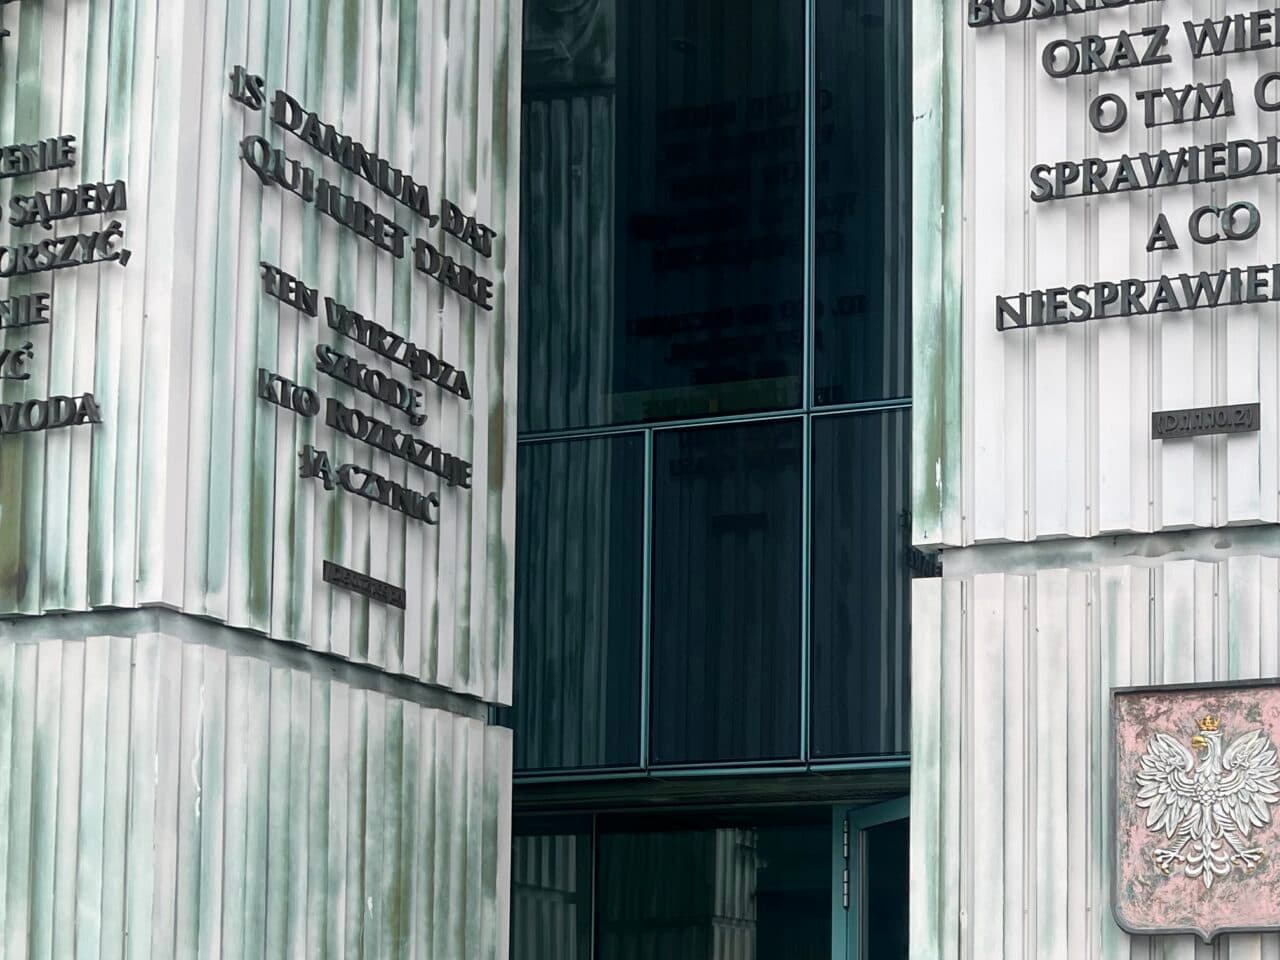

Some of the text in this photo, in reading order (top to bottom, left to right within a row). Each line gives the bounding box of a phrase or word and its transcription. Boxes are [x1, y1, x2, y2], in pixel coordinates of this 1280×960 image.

[1041, 25, 1172, 78] ORAZ
[1089, 92, 1128, 133] O
[1135, 79, 1236, 128] TYM
[230, 65, 497, 258] IS DAMNUM, DAT
[9, 180, 127, 230] SĄDEM
[240, 135, 494, 311] QUI IUBET DARE
[1146, 200, 1261, 252] A CO
[260, 261, 319, 318] TEN
[258, 368, 473, 489] KTO ROZKAZUJE
